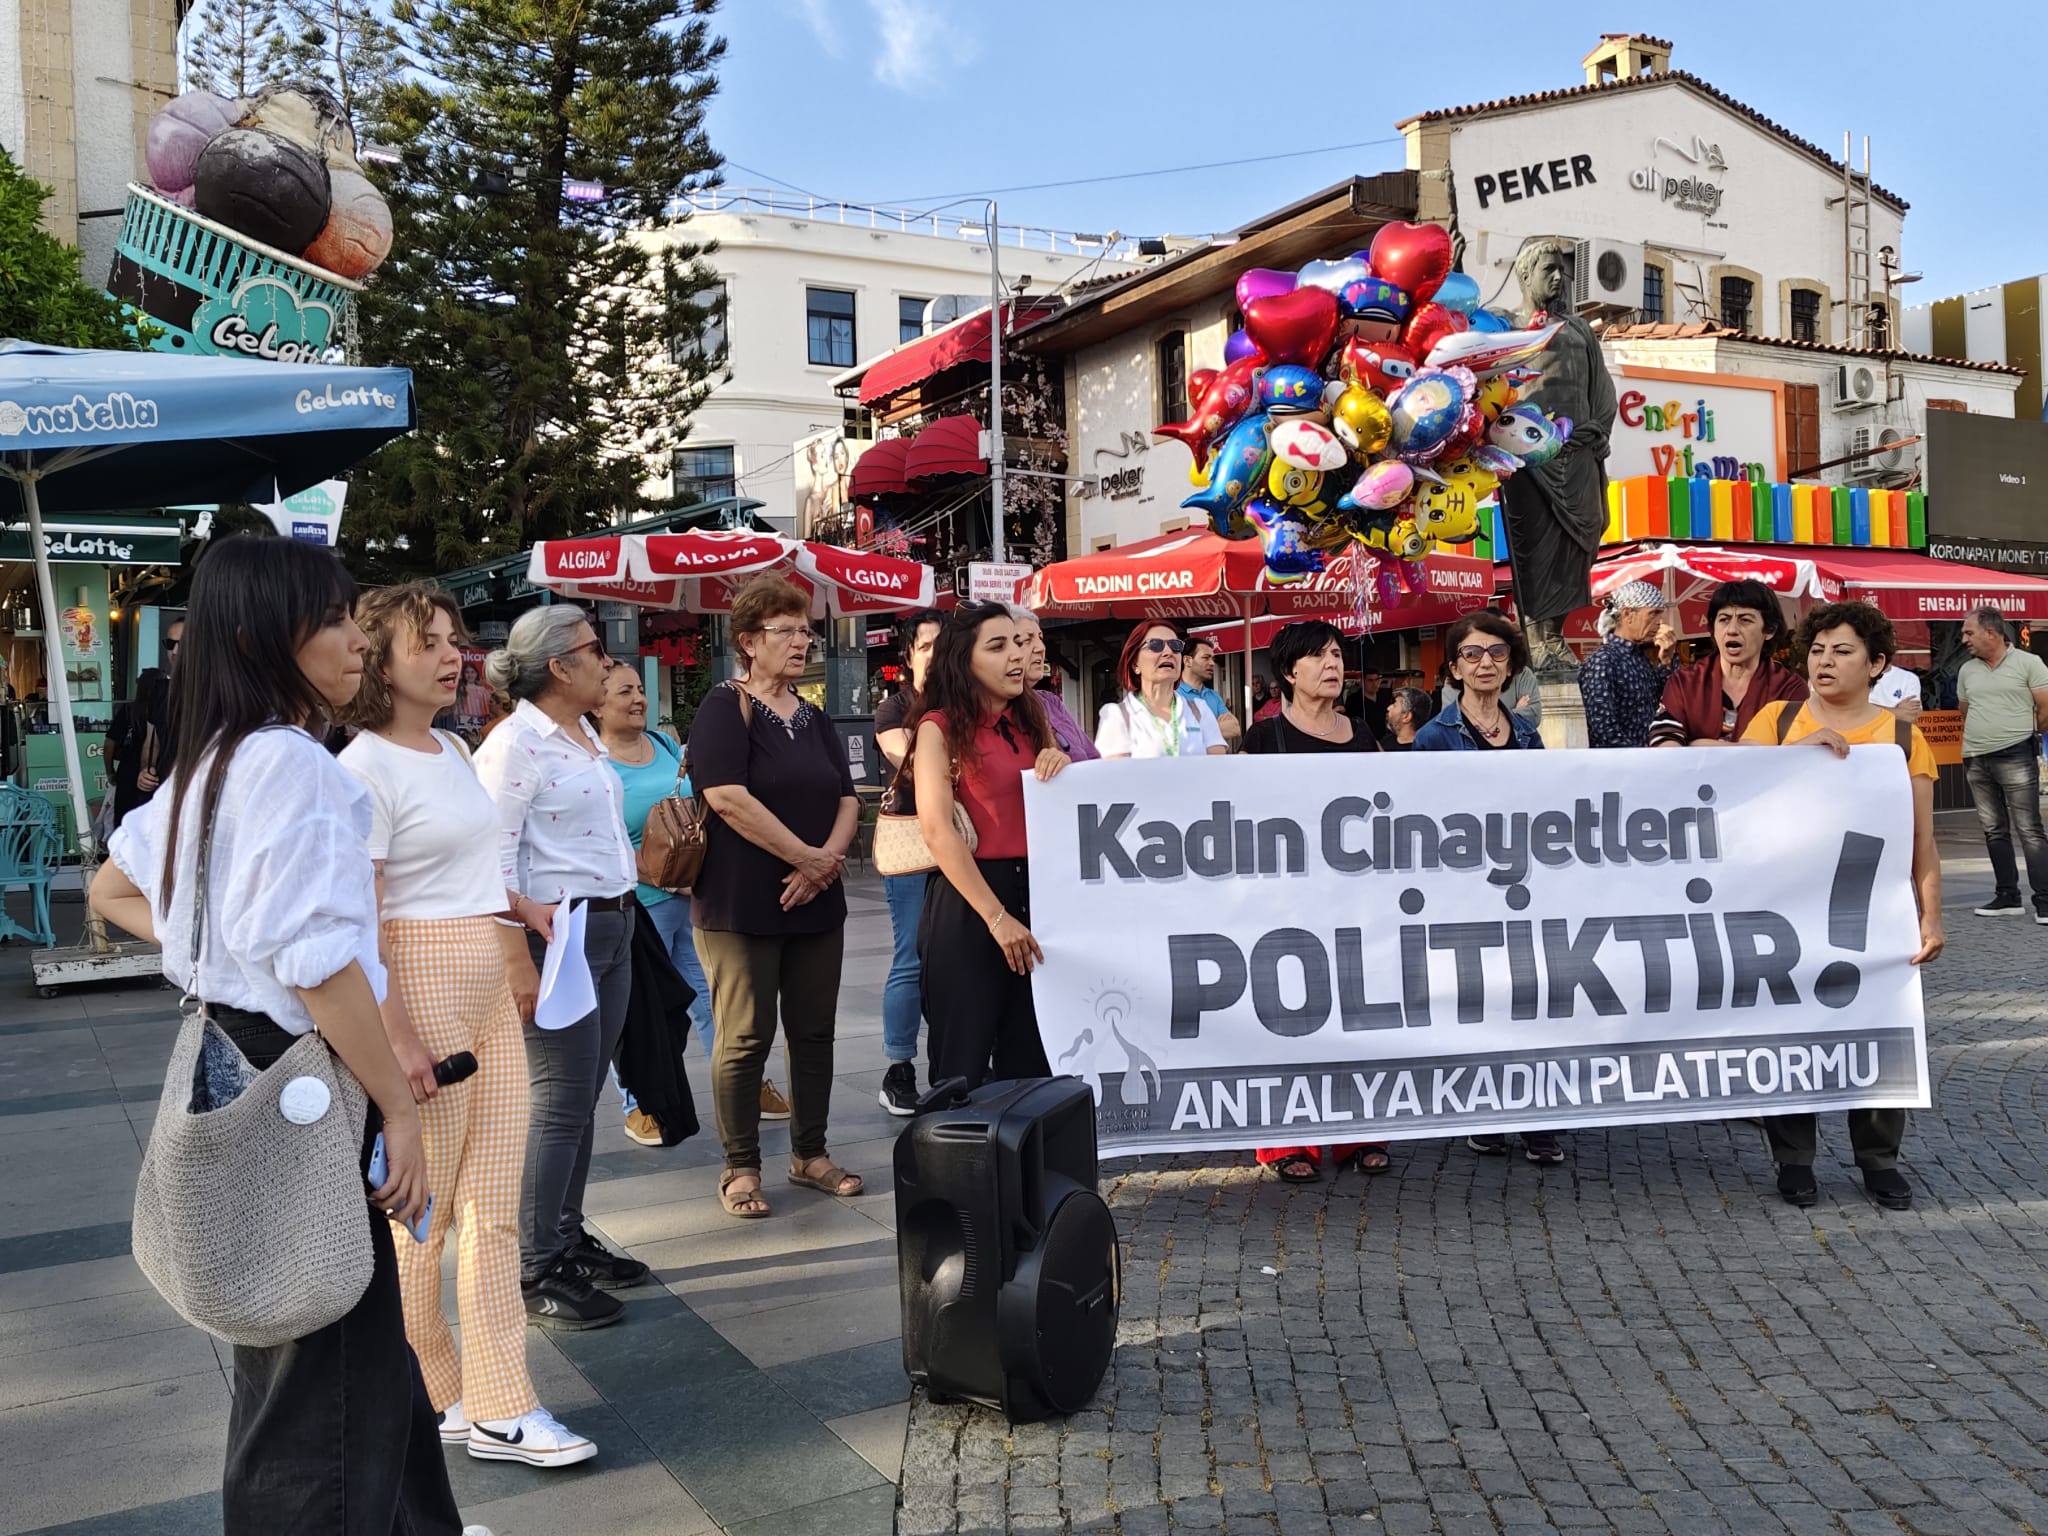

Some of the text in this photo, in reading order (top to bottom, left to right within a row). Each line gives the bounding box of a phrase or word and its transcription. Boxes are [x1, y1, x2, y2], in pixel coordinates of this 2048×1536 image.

[1474, 153, 1597, 209] PEKER
[1662, 174, 1725, 207] peker
[295, 384, 396, 414] GeLatte
[2000, 474, 2026, 484] Video 1
[1929, 543, 1996, 564] KORONAPAY
[1998, 549, 2036, 564] MONEY
[1075, 570, 1193, 595] TADINI ÇIKAR
[1430, 568, 1483, 590] TADINI ÇIKAR
[1918, 593, 1967, 611] ENERJİ
[1077, 784, 1721, 886] Kadın Cinayetleri
[1170, 1040, 1880, 1131] ANTALYA KADIN PLATFORMU
